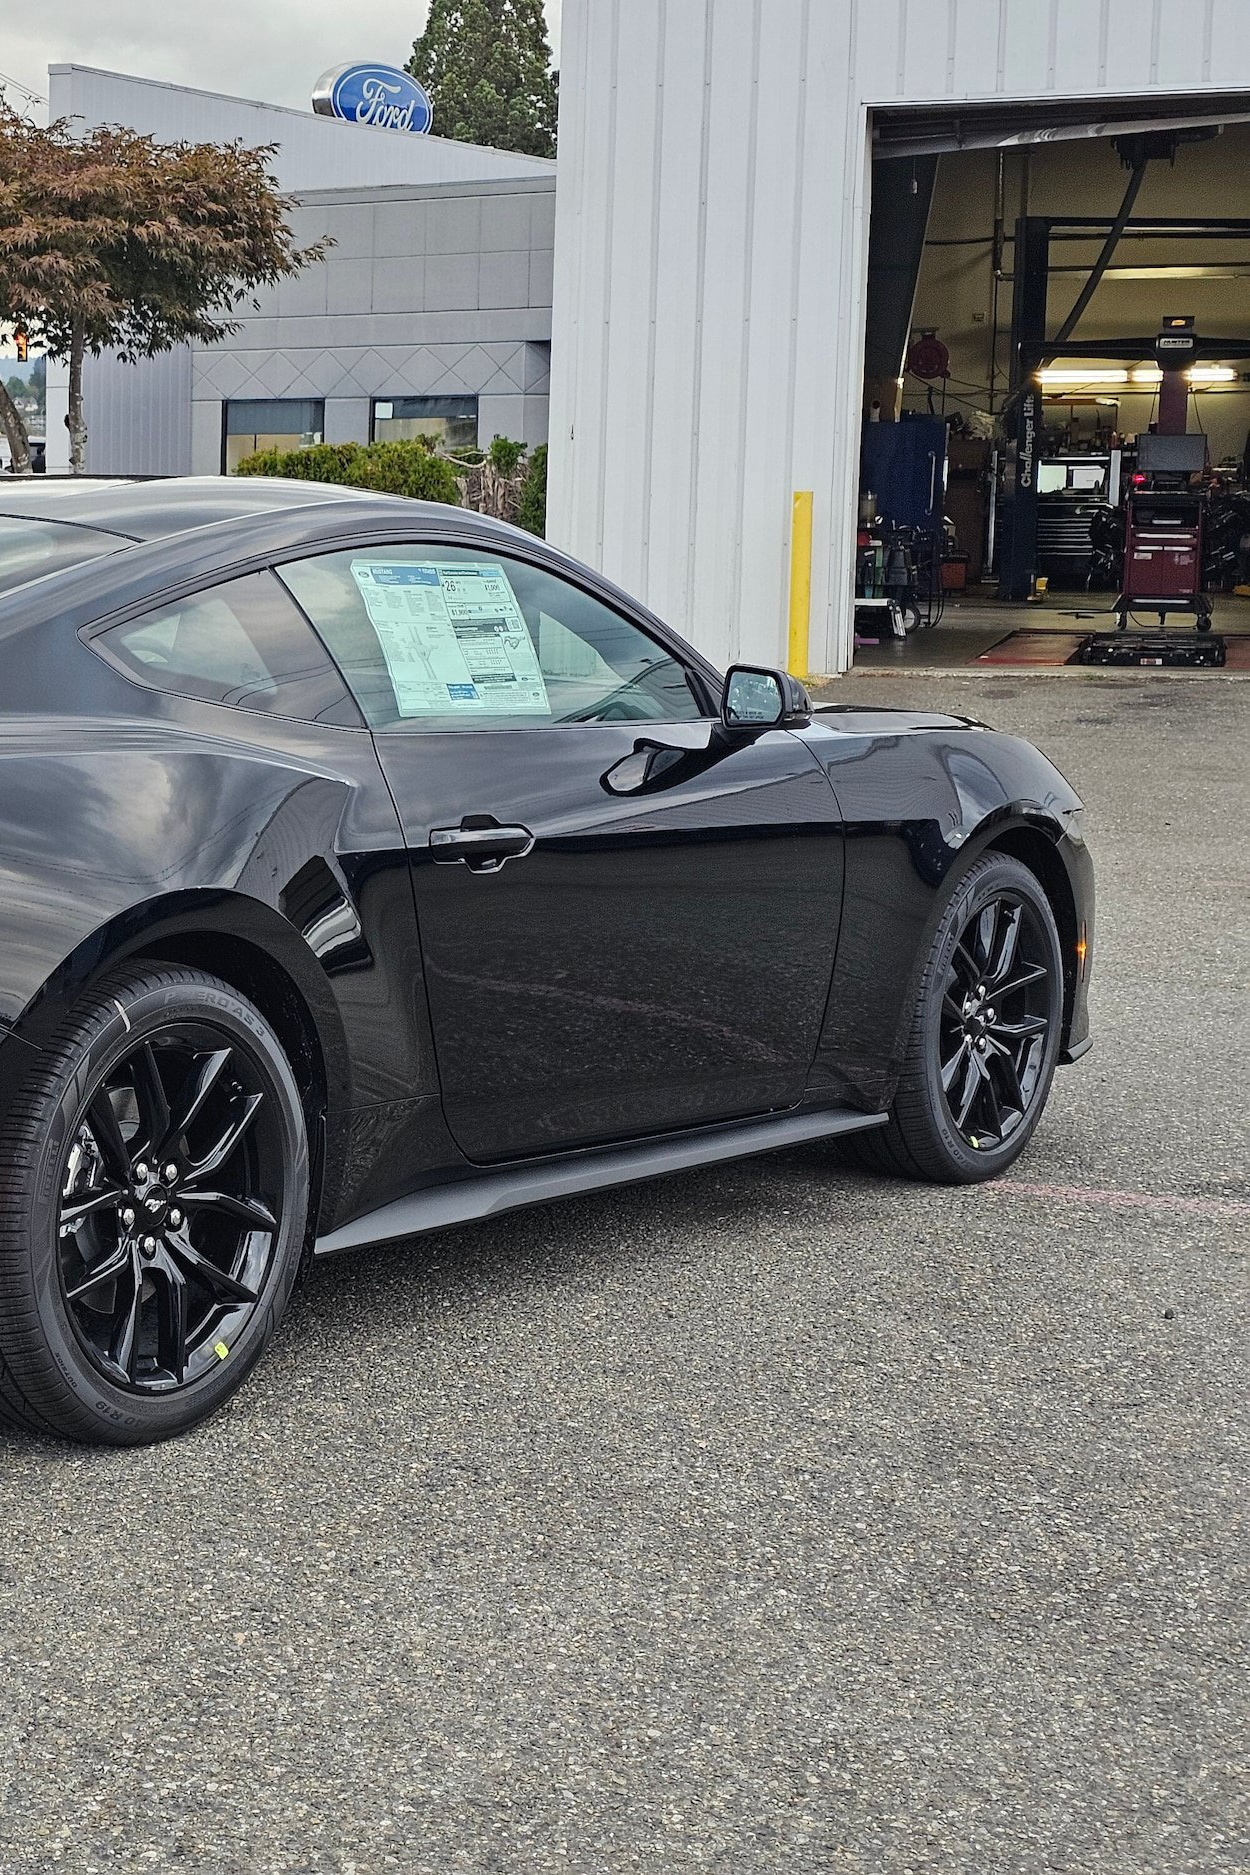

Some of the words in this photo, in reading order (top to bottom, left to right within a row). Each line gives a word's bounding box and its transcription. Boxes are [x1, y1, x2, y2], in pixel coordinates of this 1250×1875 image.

[355, 78, 416, 132] Ford
[1023, 393, 1035, 417] Lifts
[1019, 418, 1036, 488] Challenger
[445, 580, 457, 592] 26
[95, 1401, 123, 1421] R19
